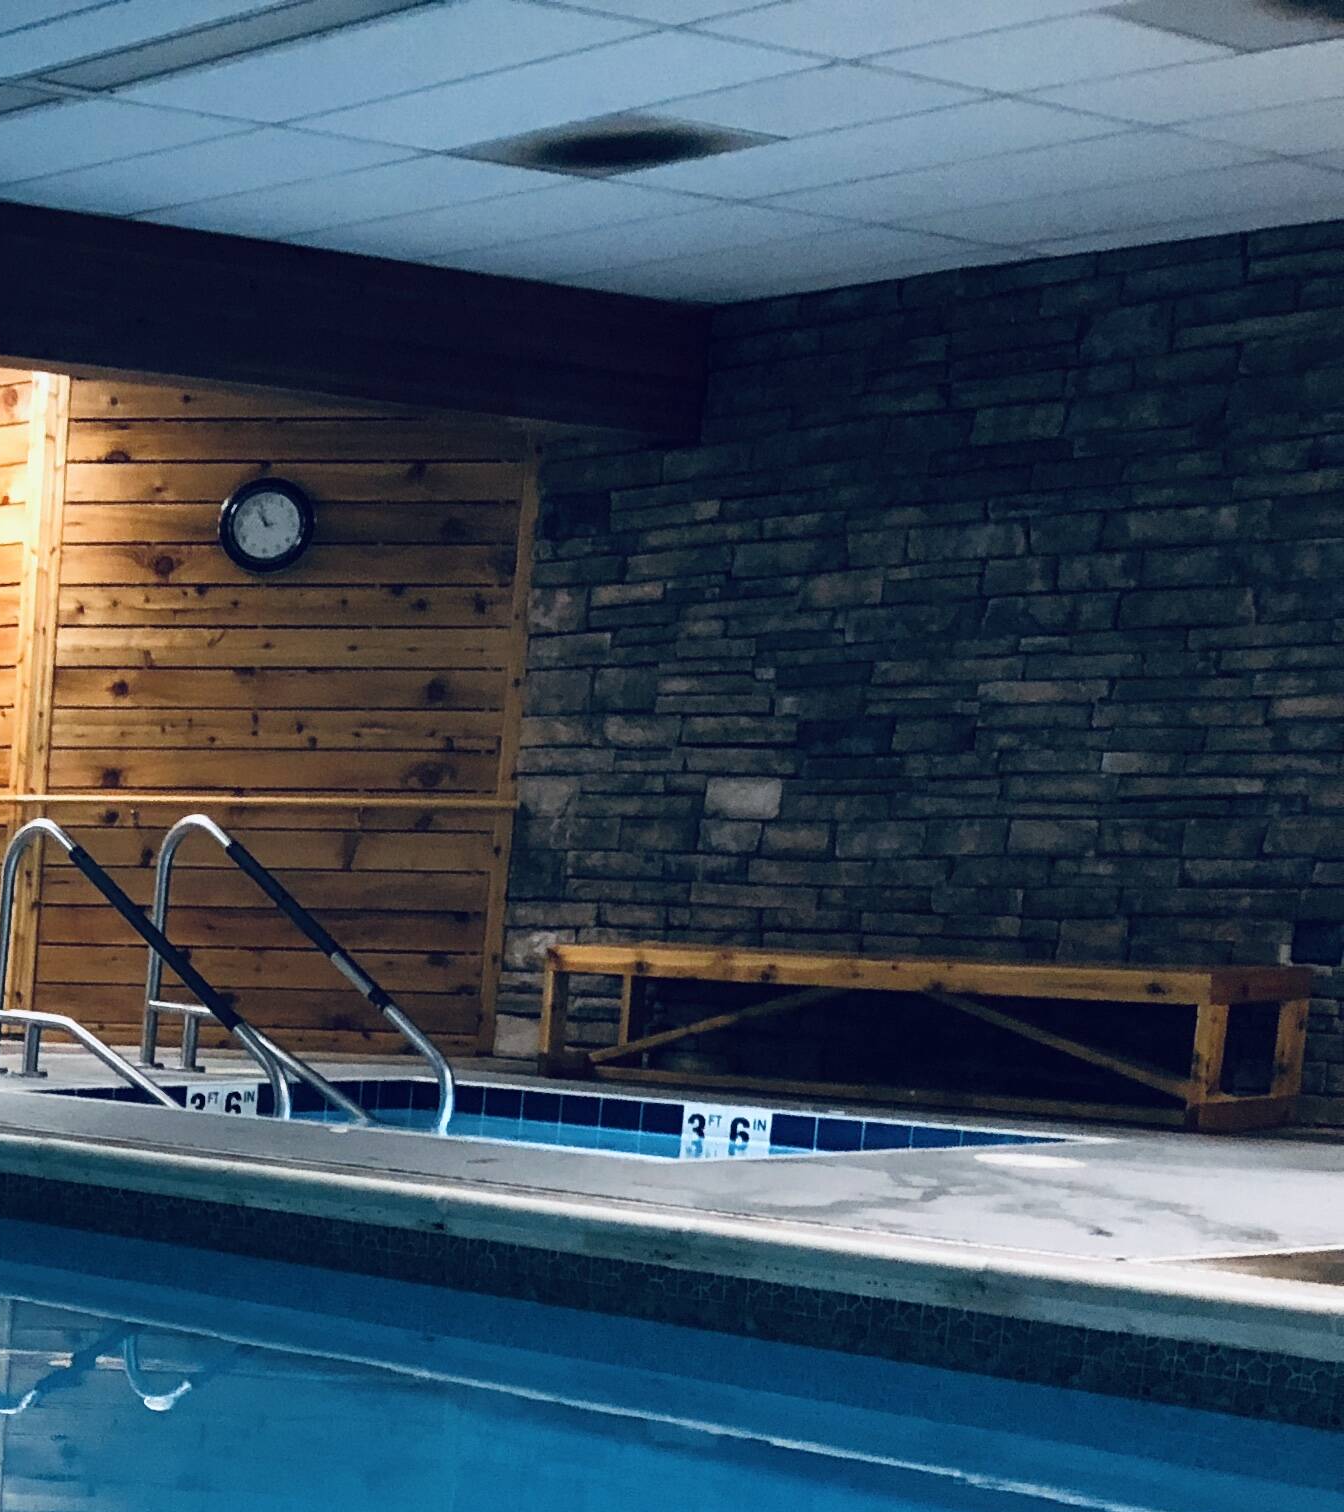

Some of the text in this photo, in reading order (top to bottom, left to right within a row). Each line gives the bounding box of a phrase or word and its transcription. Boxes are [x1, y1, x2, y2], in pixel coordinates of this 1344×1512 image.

[208, 1091, 220, 1104] FT
[244, 1090, 255, 1103] IN
[688, 1113, 767, 1143] 3 FT 6 IN
